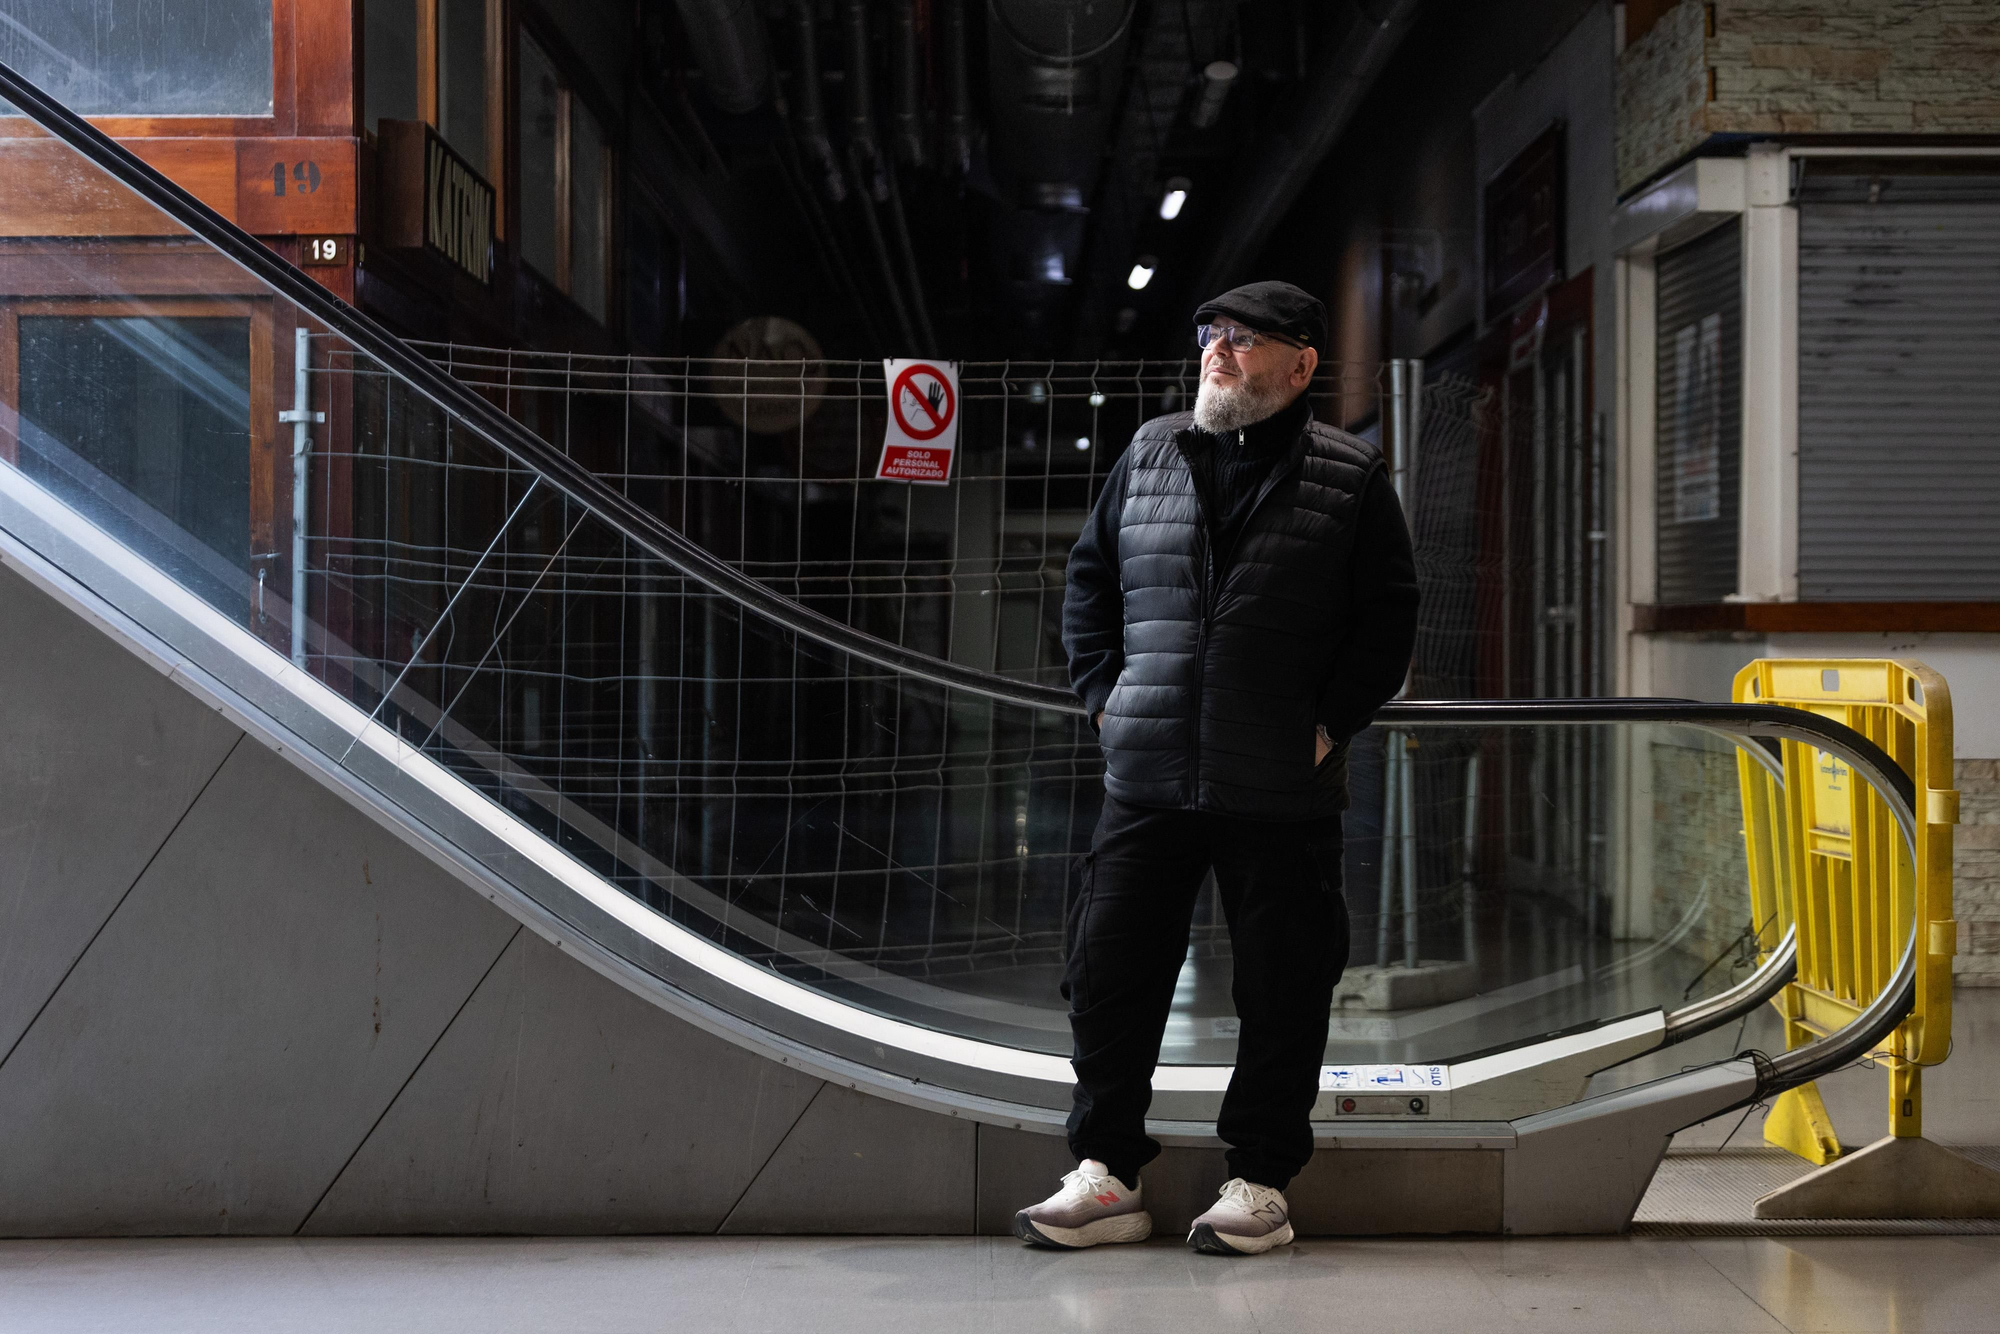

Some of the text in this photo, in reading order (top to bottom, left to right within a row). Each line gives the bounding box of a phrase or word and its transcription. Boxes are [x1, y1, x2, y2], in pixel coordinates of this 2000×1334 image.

[272, 161, 321, 196] 19
[312, 238, 337, 260] 19
[907, 450, 931, 459] SOLO
[893, 458, 940, 468] PERSONAL
[885, 465, 944, 477] AUTORIZADO
[1430, 1067, 1442, 1086] OTIS
